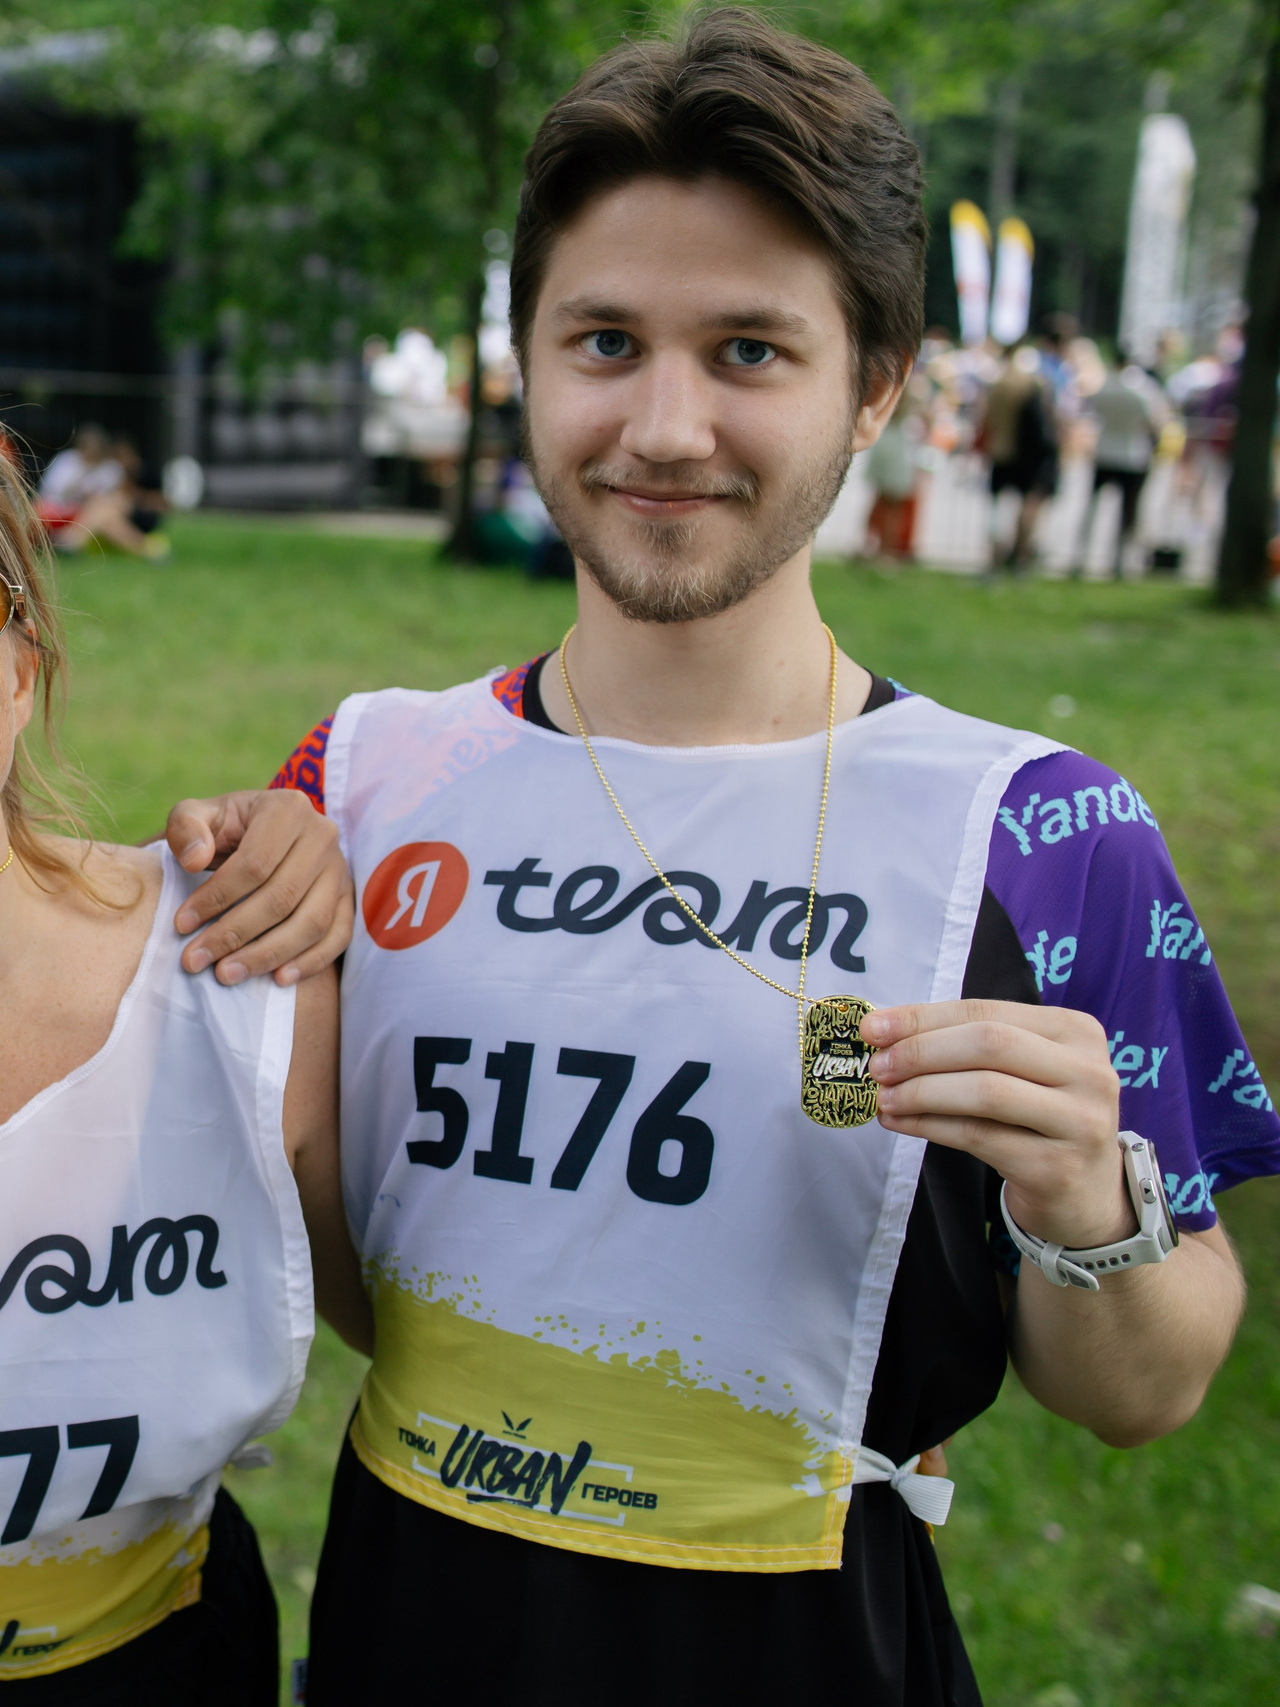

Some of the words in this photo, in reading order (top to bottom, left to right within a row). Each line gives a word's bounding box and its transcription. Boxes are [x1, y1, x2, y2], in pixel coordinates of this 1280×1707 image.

[998, 776, 1159, 857] Yande
[483, 857, 869, 973] team
[813, 1052, 870, 1080] URBAN
[406, 1036, 715, 1206] 5176
[398, 1427, 436, 1457] ГОНКА
[440, 1424, 592, 1515] URBAN
[582, 1483, 658, 1509] ГЕРОЕВ
